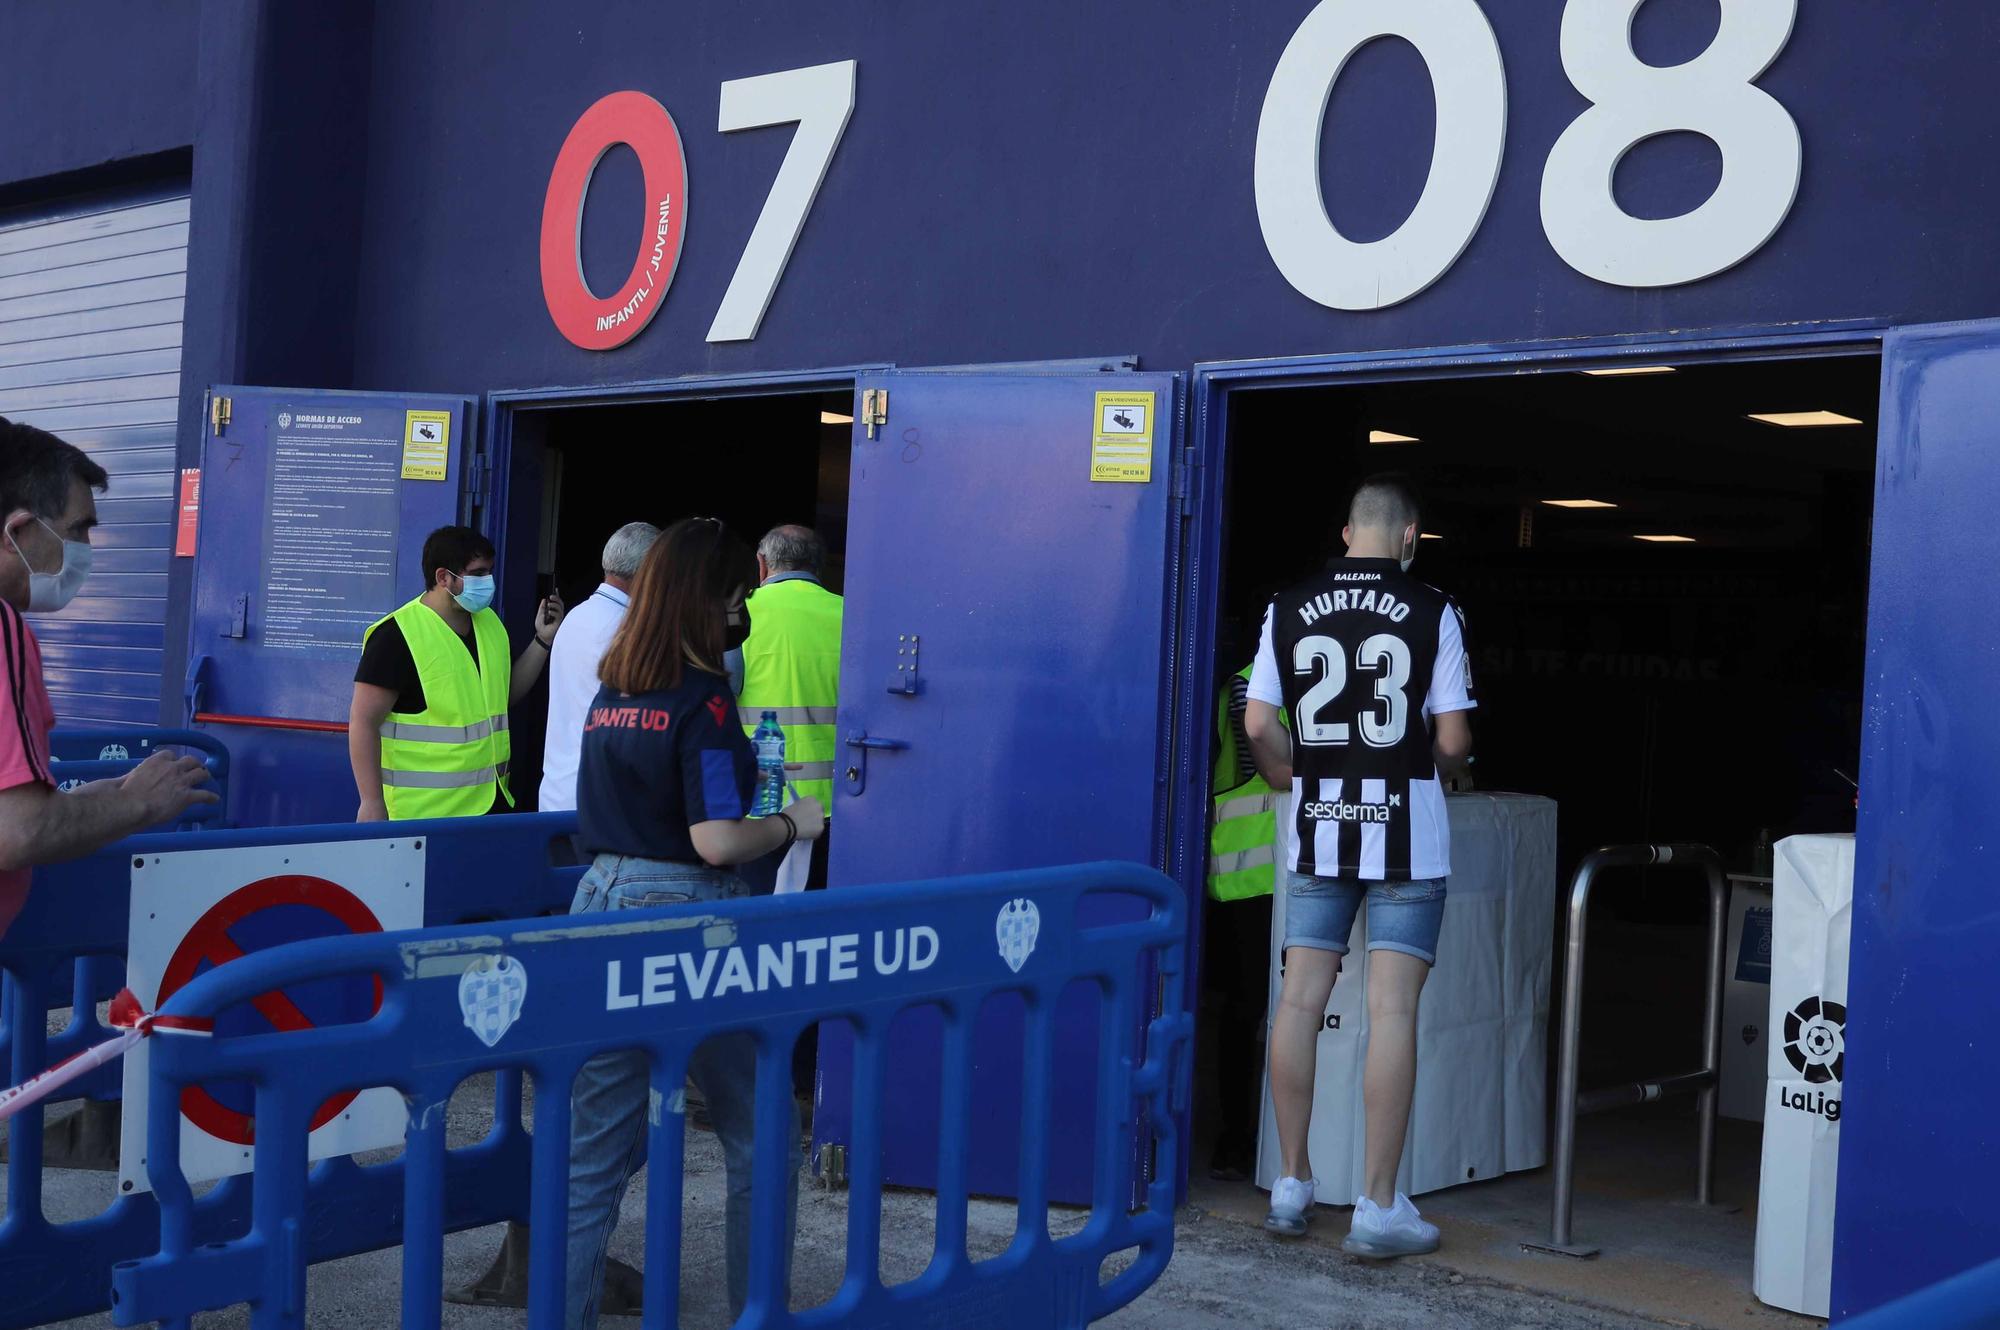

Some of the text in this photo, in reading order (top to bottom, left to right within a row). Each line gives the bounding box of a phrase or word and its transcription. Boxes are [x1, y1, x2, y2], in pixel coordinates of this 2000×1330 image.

[1254, 0, 1803, 311] 08
[540, 59, 857, 351] 07
[596, 193, 670, 331] INFANTIL / JUVENIL
[296, 414, 362, 424] NORMAS DE ACCESO
[901, 427, 922, 464] 8
[1333, 573, 1382, 581] BALEARIA
[1298, 588, 1410, 626] HURTADO
[1293, 633, 1412, 748] 23
[641, 708, 670, 732] UD
[1304, 799, 1390, 821] sesderma
[606, 925, 940, 1011] LEVANTE UD
[1780, 1086, 1842, 1122] LaLig
